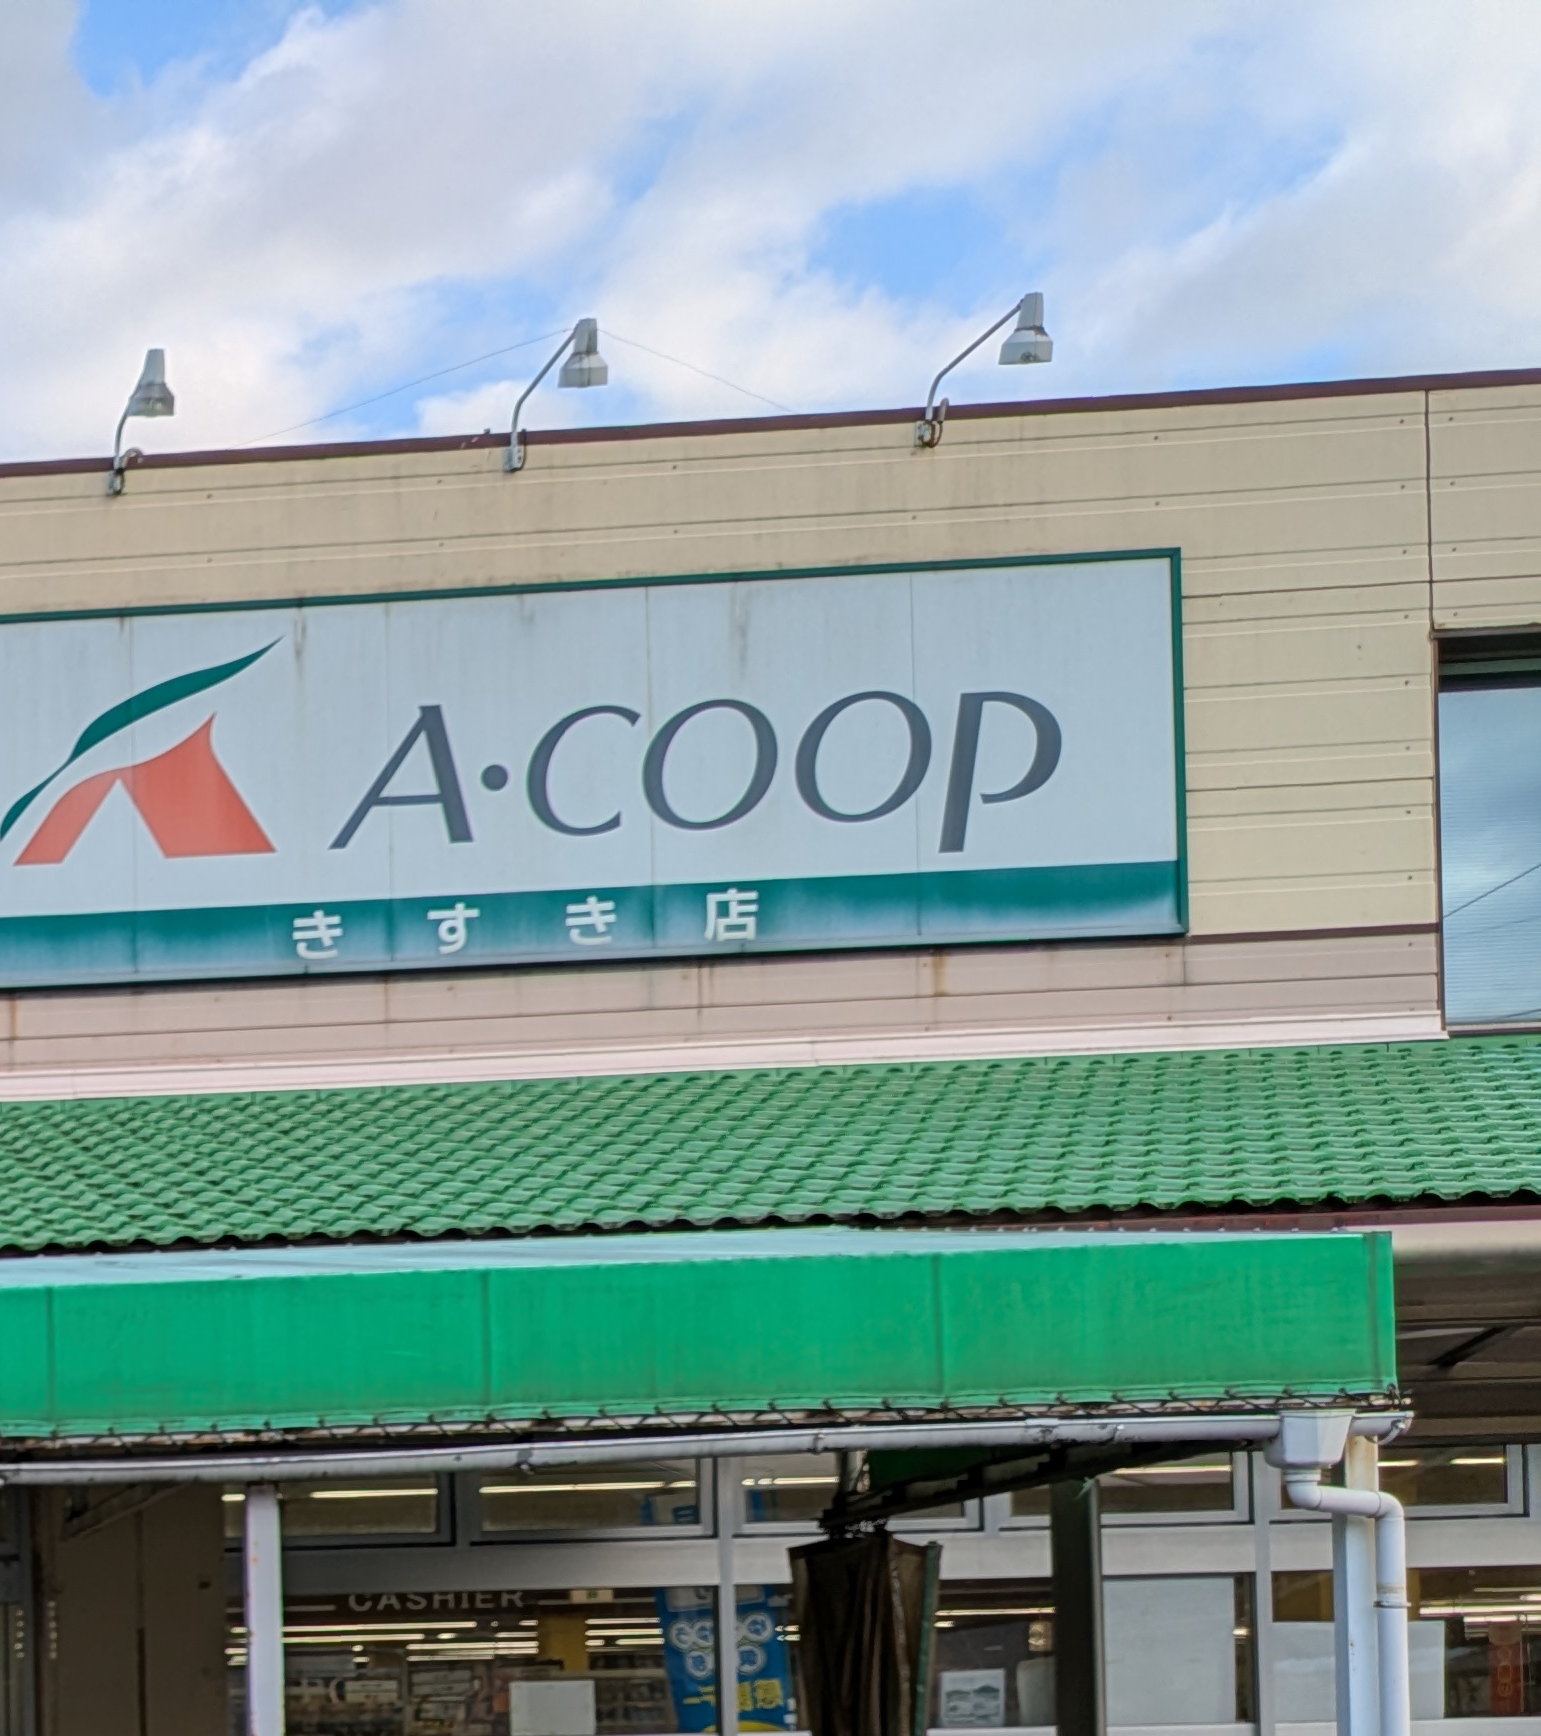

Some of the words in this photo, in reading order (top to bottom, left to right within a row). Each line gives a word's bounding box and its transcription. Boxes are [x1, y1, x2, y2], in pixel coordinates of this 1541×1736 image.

[291, 887, 759, 960] きすき店
[347, 1590, 524, 1612] CASHIER
